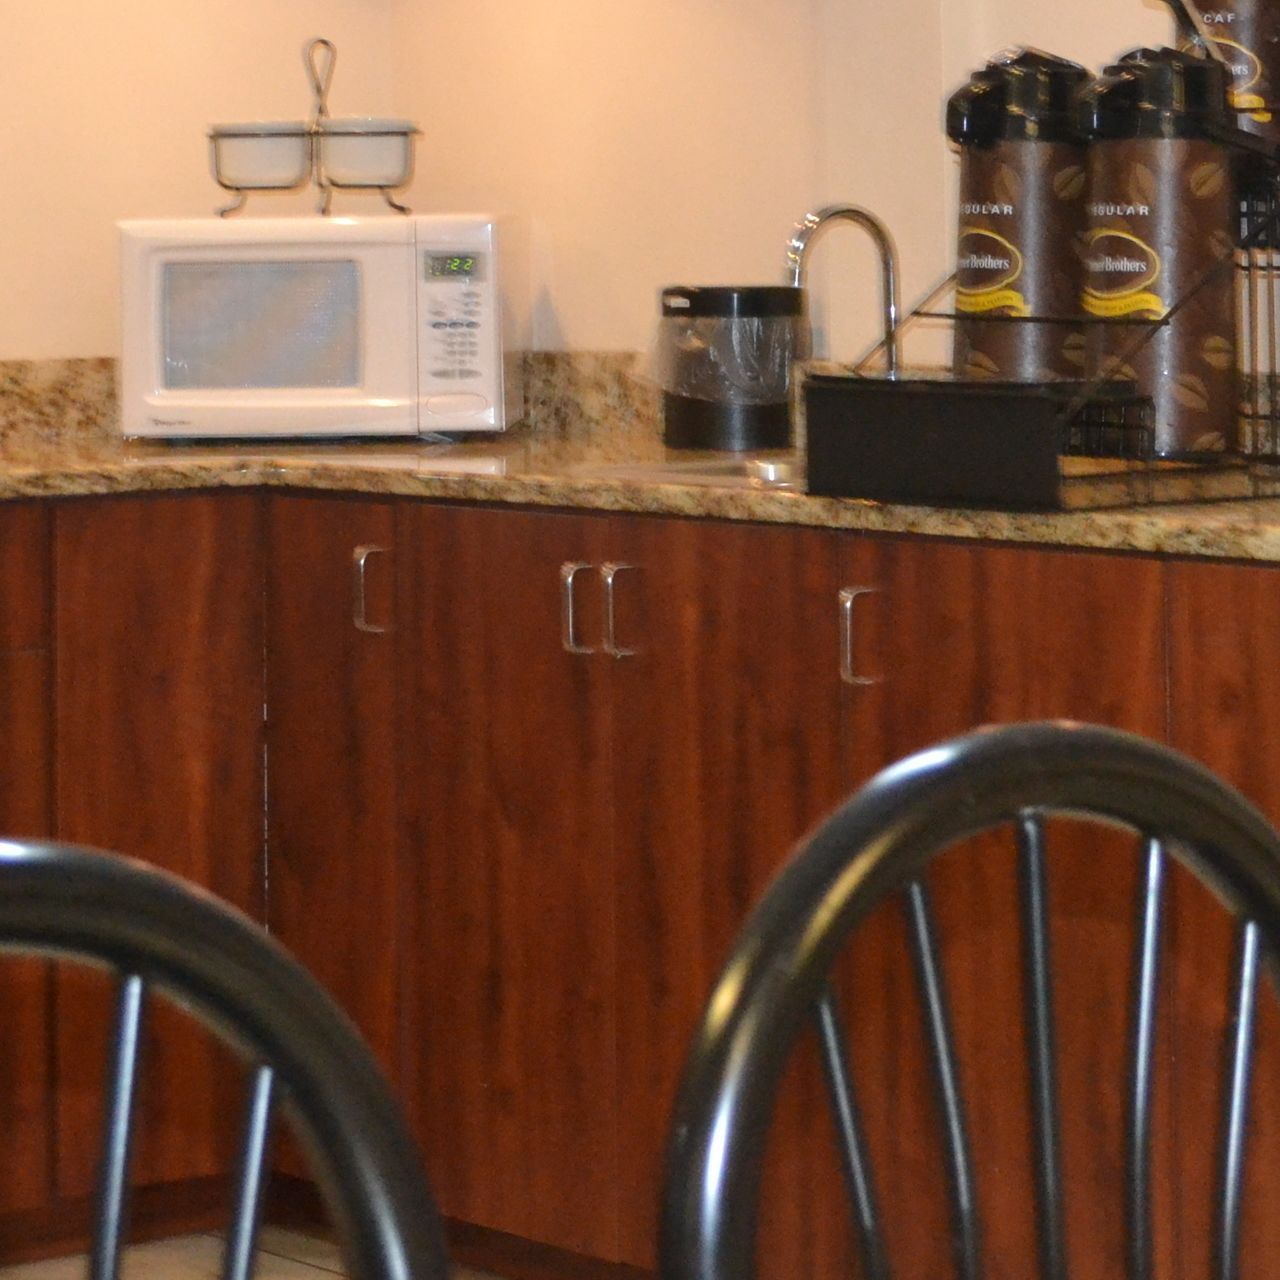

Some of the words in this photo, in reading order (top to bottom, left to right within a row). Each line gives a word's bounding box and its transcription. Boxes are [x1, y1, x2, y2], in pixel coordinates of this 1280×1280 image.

[1203, 12, 1236, 24] CAF
[960, 204, 1014, 216] GULAR
[970, 254, 1010, 270] Brothers
[1105, 256, 1147, 272] Brothers
